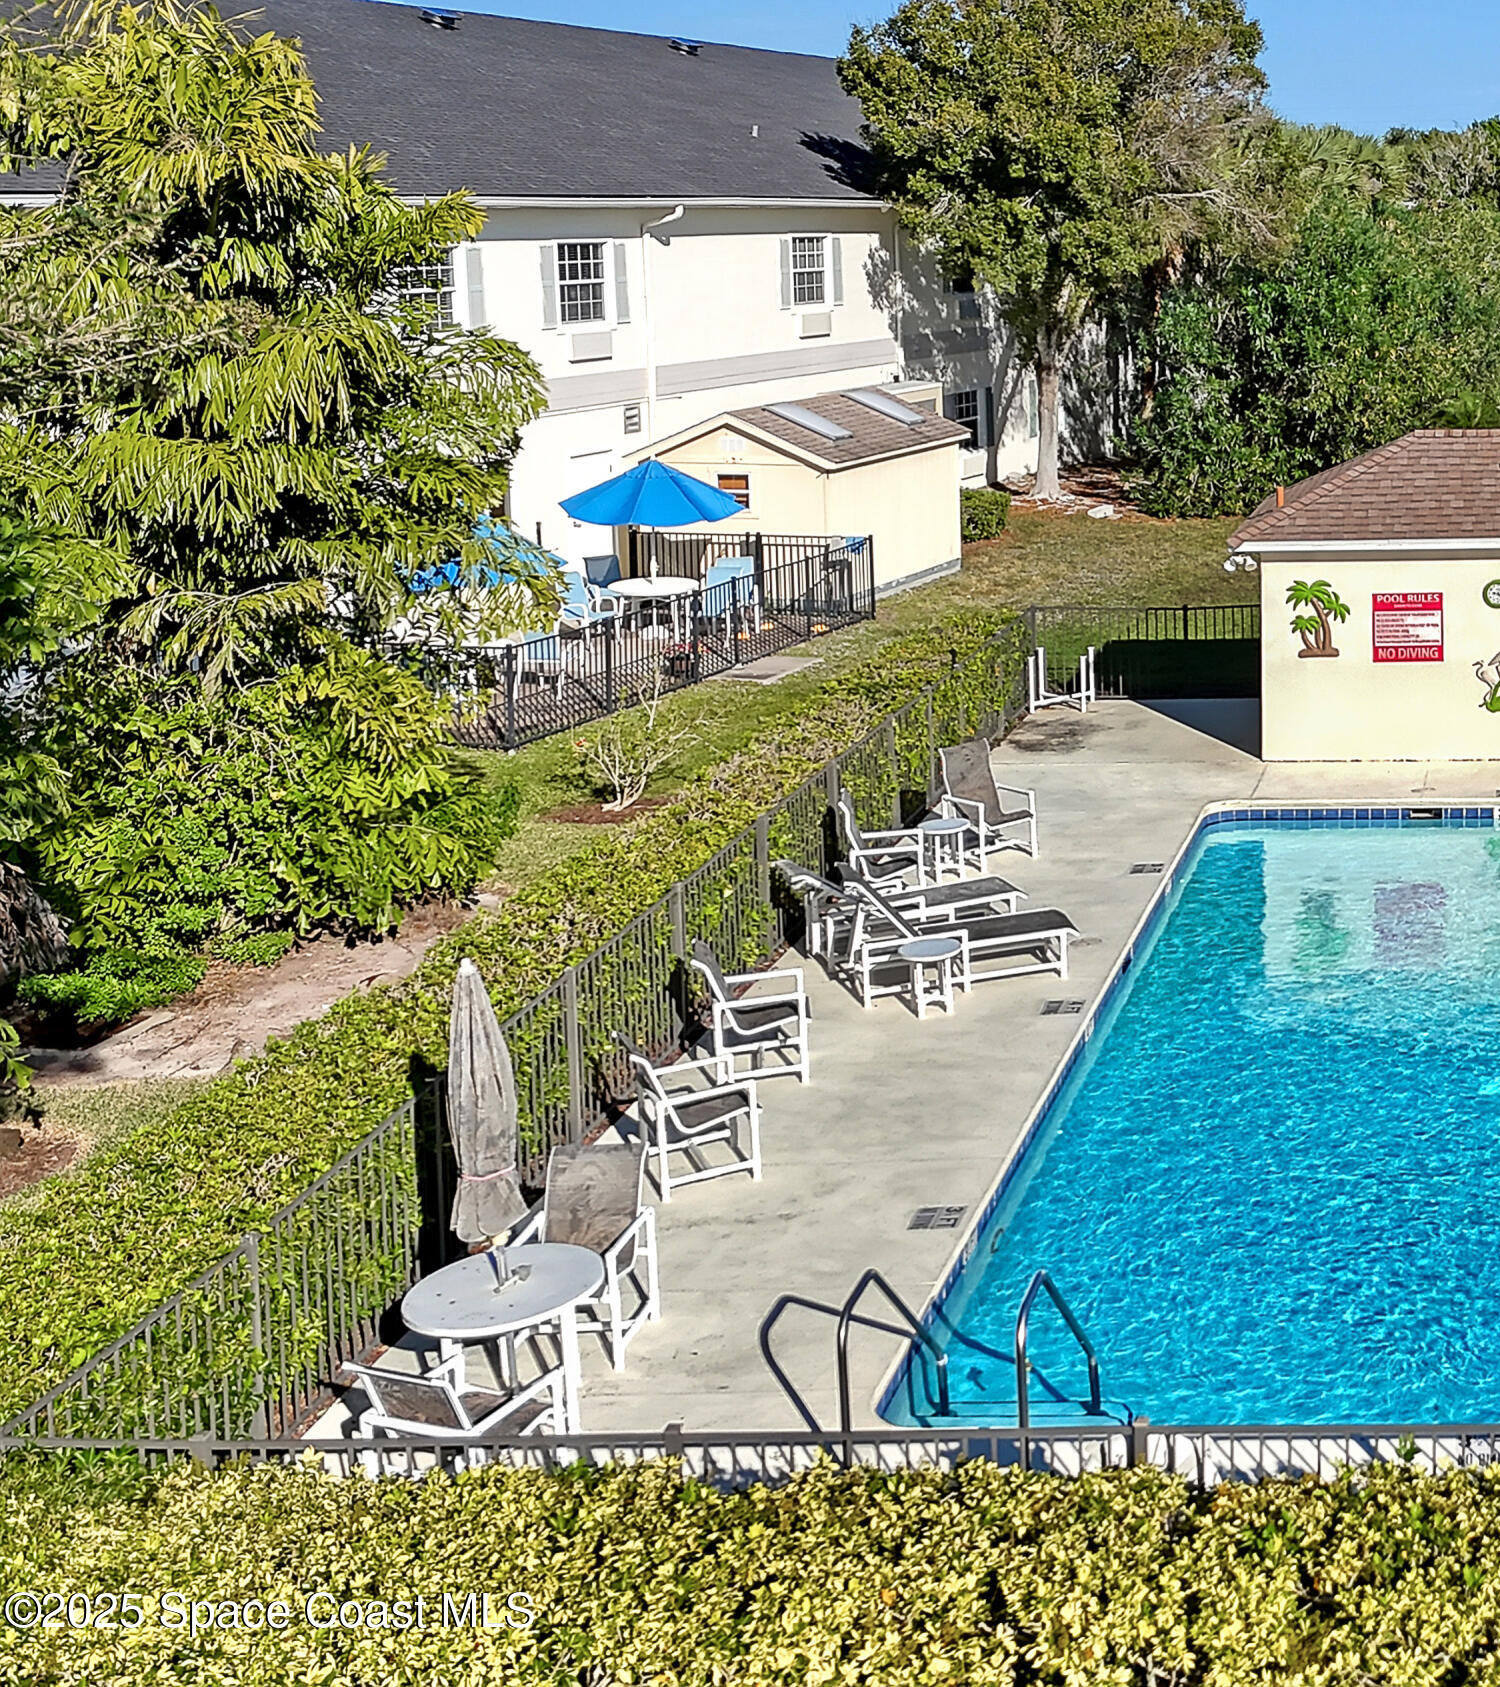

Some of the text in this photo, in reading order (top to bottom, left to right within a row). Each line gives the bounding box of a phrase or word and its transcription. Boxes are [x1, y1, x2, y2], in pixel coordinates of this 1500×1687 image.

[1376, 593, 1440, 603] POOL RULES
[1378, 647, 1439, 660] NO DIVING
[935, 1217, 959, 1228] FT
